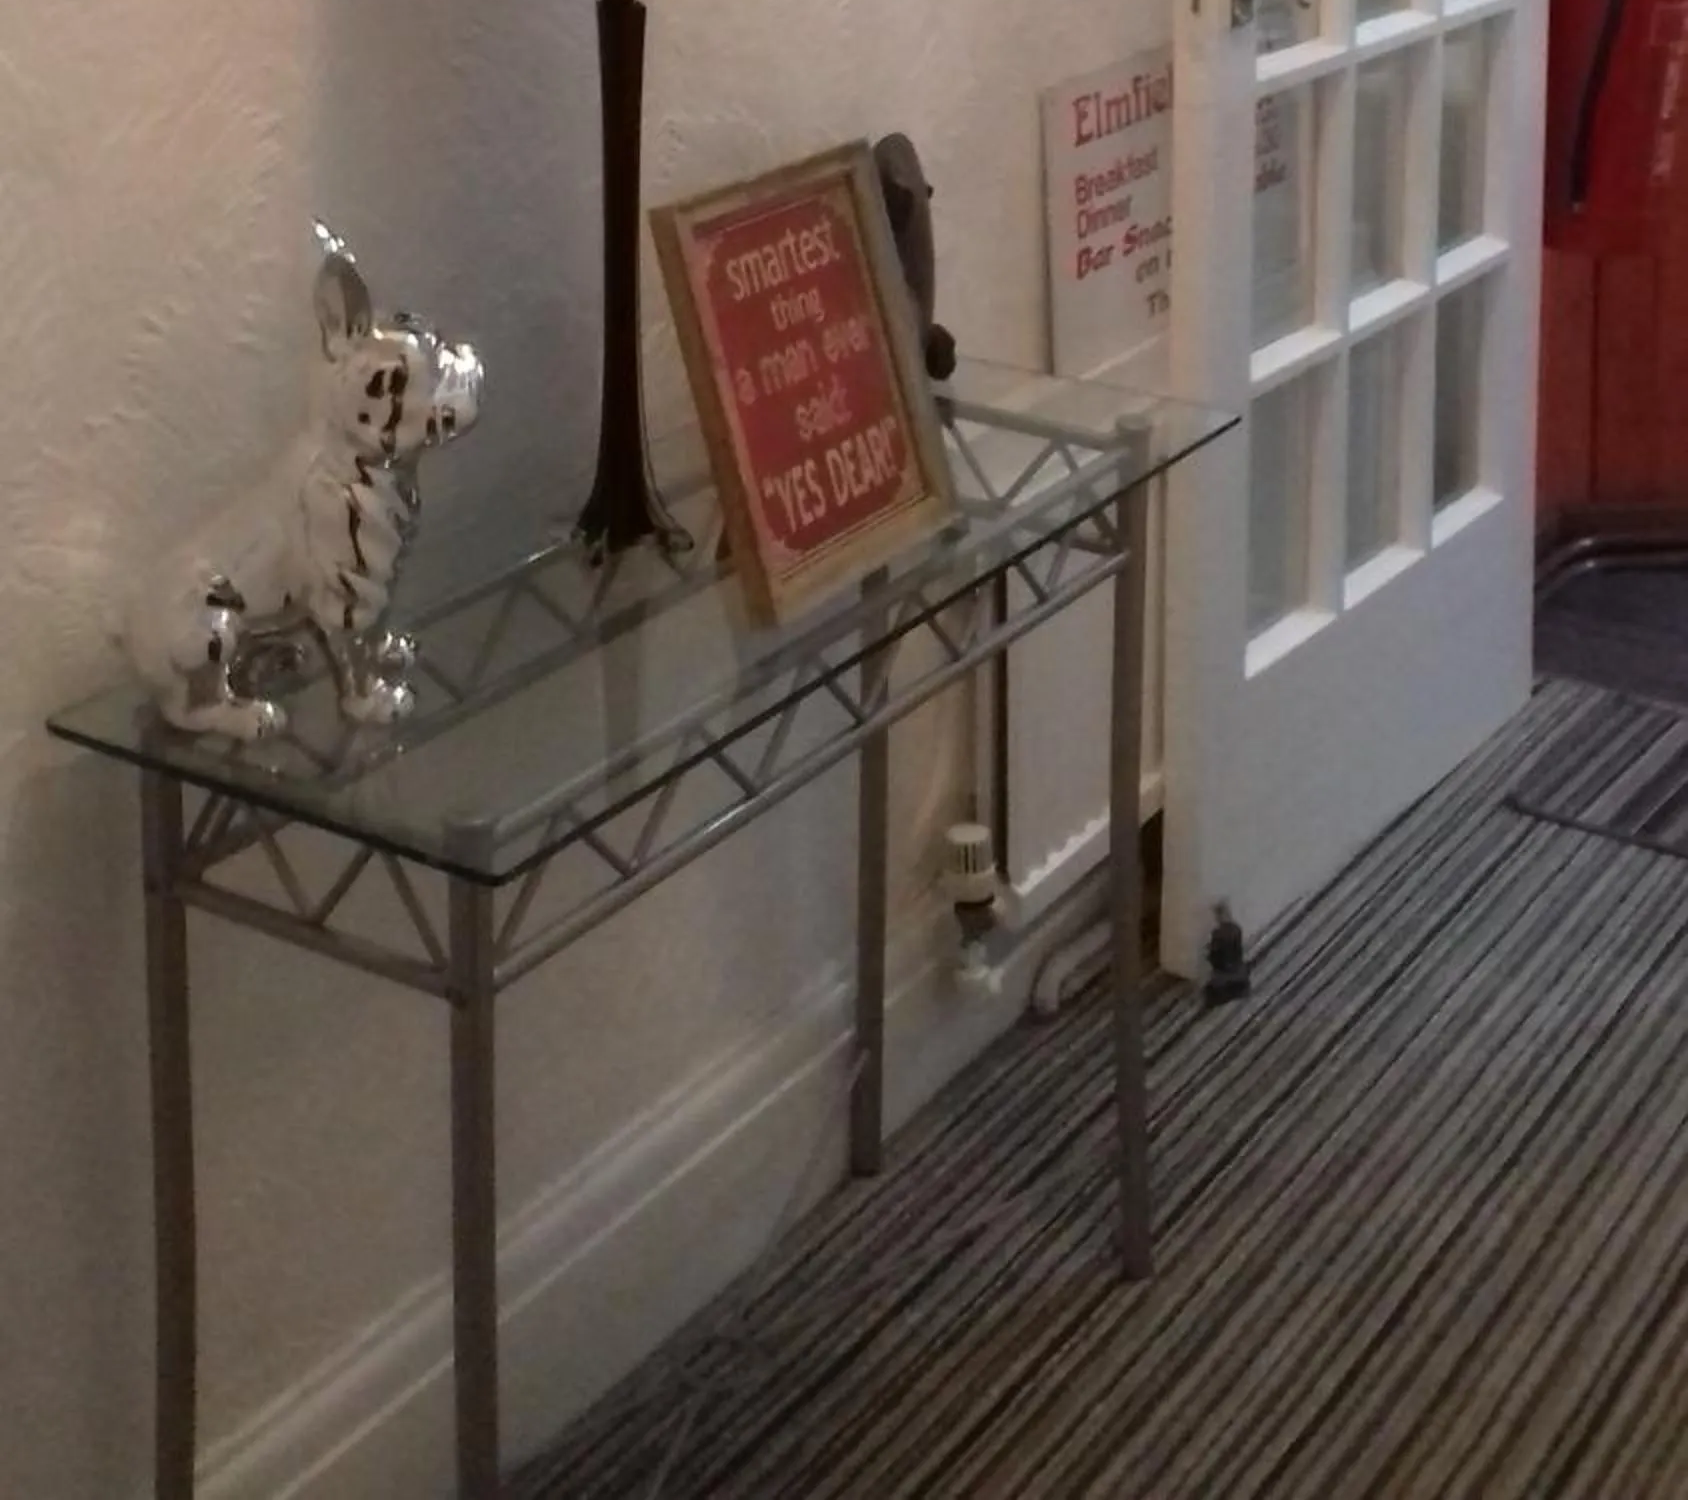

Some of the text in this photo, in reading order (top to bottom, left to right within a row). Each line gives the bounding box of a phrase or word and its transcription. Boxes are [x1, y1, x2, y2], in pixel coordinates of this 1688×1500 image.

[726, 214, 841, 301] smartest
[770, 285, 825, 332] thing
[735, 367, 757, 405] a
[758, 338, 821, 396] man
